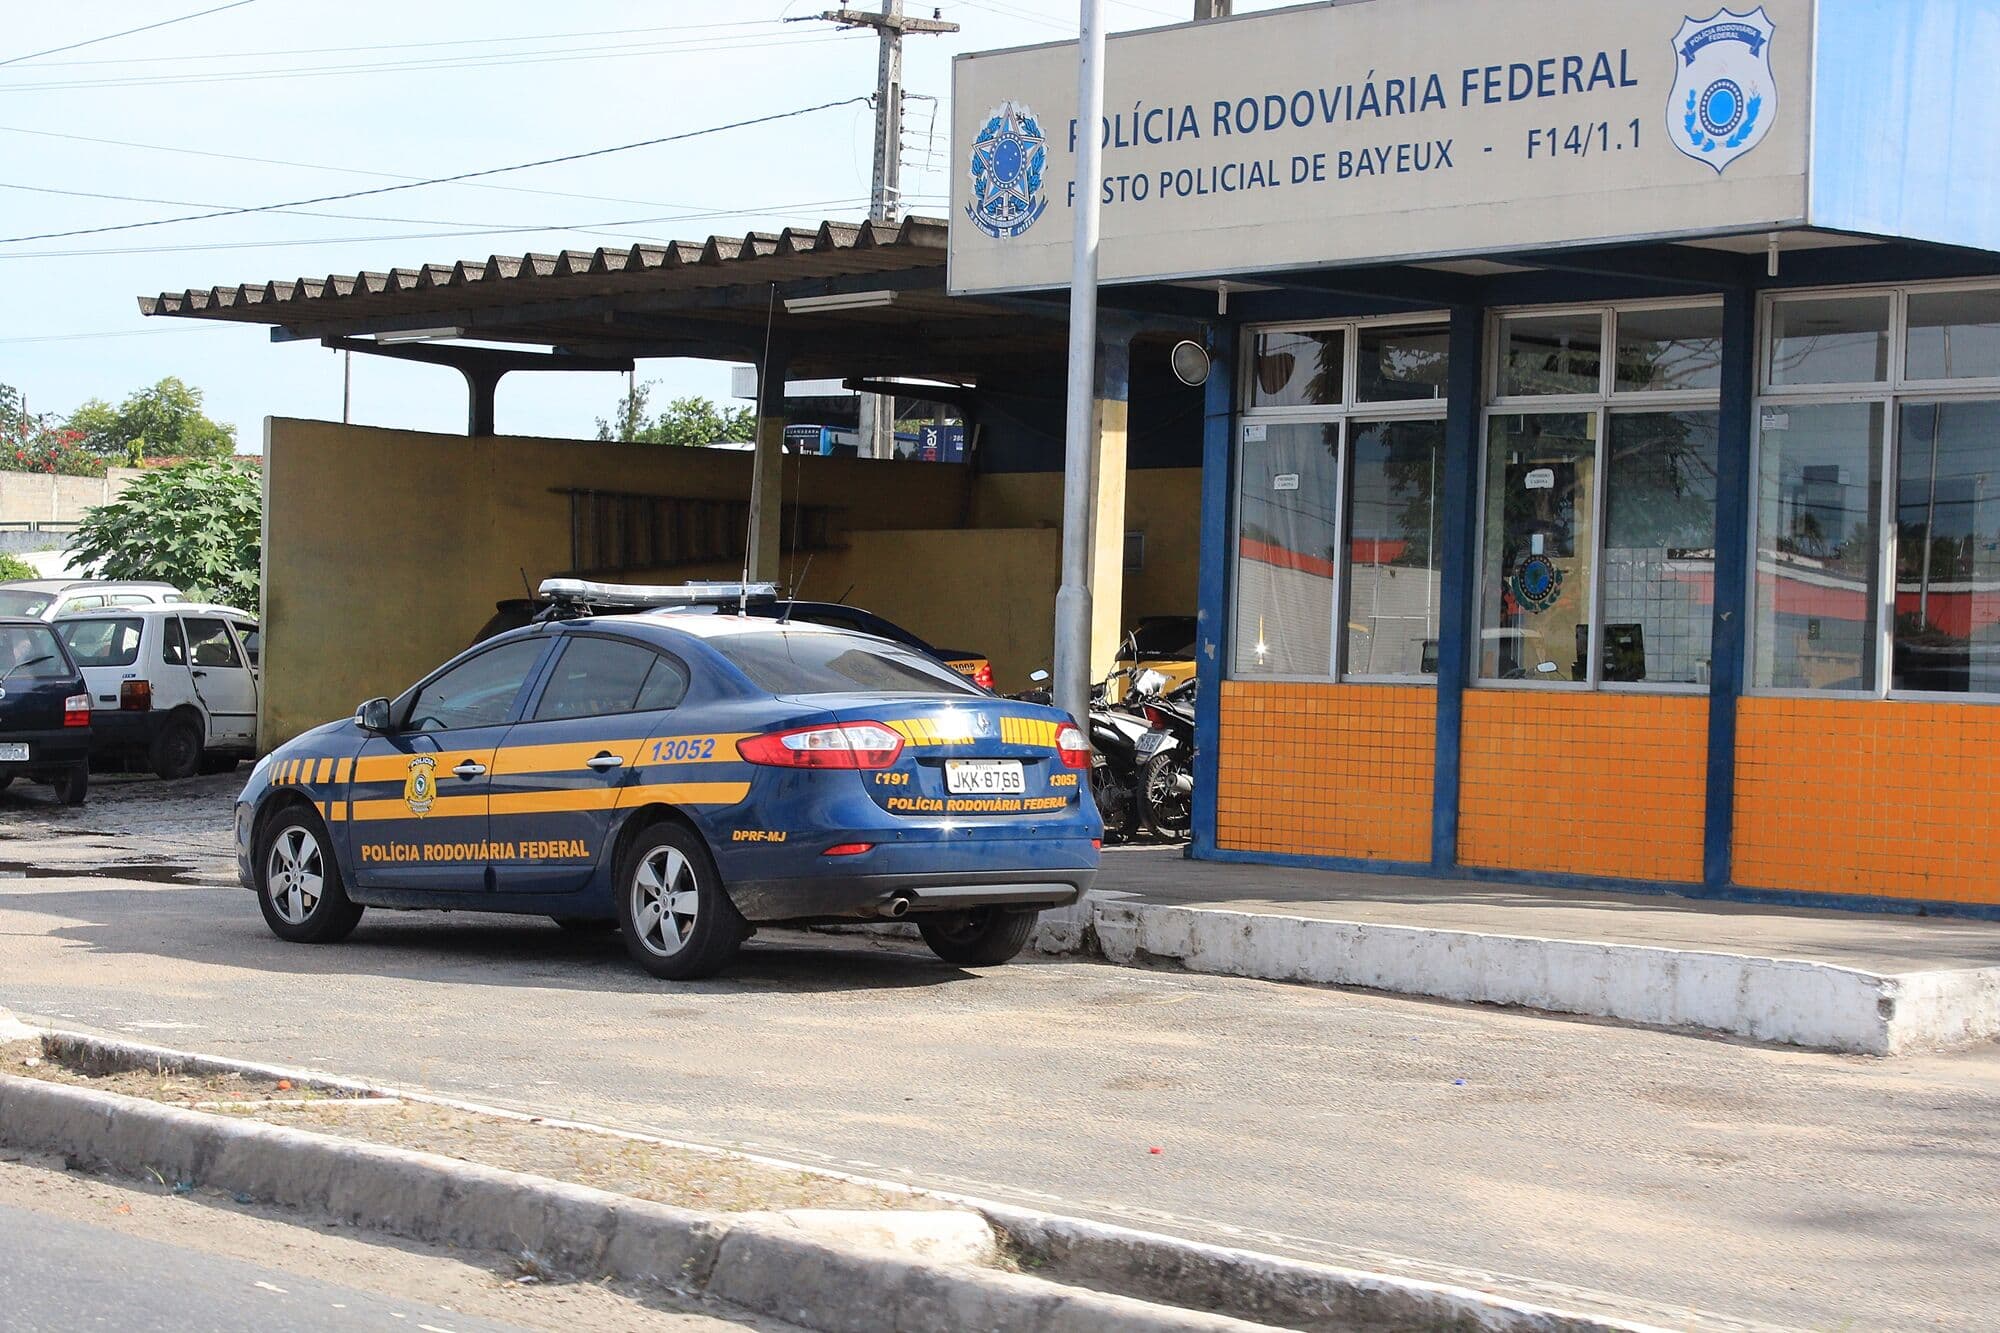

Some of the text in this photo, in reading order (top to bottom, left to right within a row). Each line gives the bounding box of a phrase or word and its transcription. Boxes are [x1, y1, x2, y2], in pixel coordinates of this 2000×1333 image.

[1708, 31, 1739, 42] FEDERAL
[1213, 70, 1446, 137] RODOVIÁRIA
[1461, 49, 1638, 108] FEDERAL
[1067, 173, 1149, 207] PSTO
[1160, 160, 1280, 198] POLICIAL
[1291, 153, 1327, 184] DE
[1338, 138, 1455, 179] BAYEUX
[1527, 118, 1640, 159] F14/1.1
[651, 738, 715, 761] 13052
[1049, 775, 1077, 786] 13052
[888, 796, 1068, 812] POLÍCIA RODOVIÁRIA FEDERAL
[732, 830, 787, 842] DPRF-MJ
[361, 839, 590, 862] POLÍCIA RODOVIÁRIA FEDERAL
